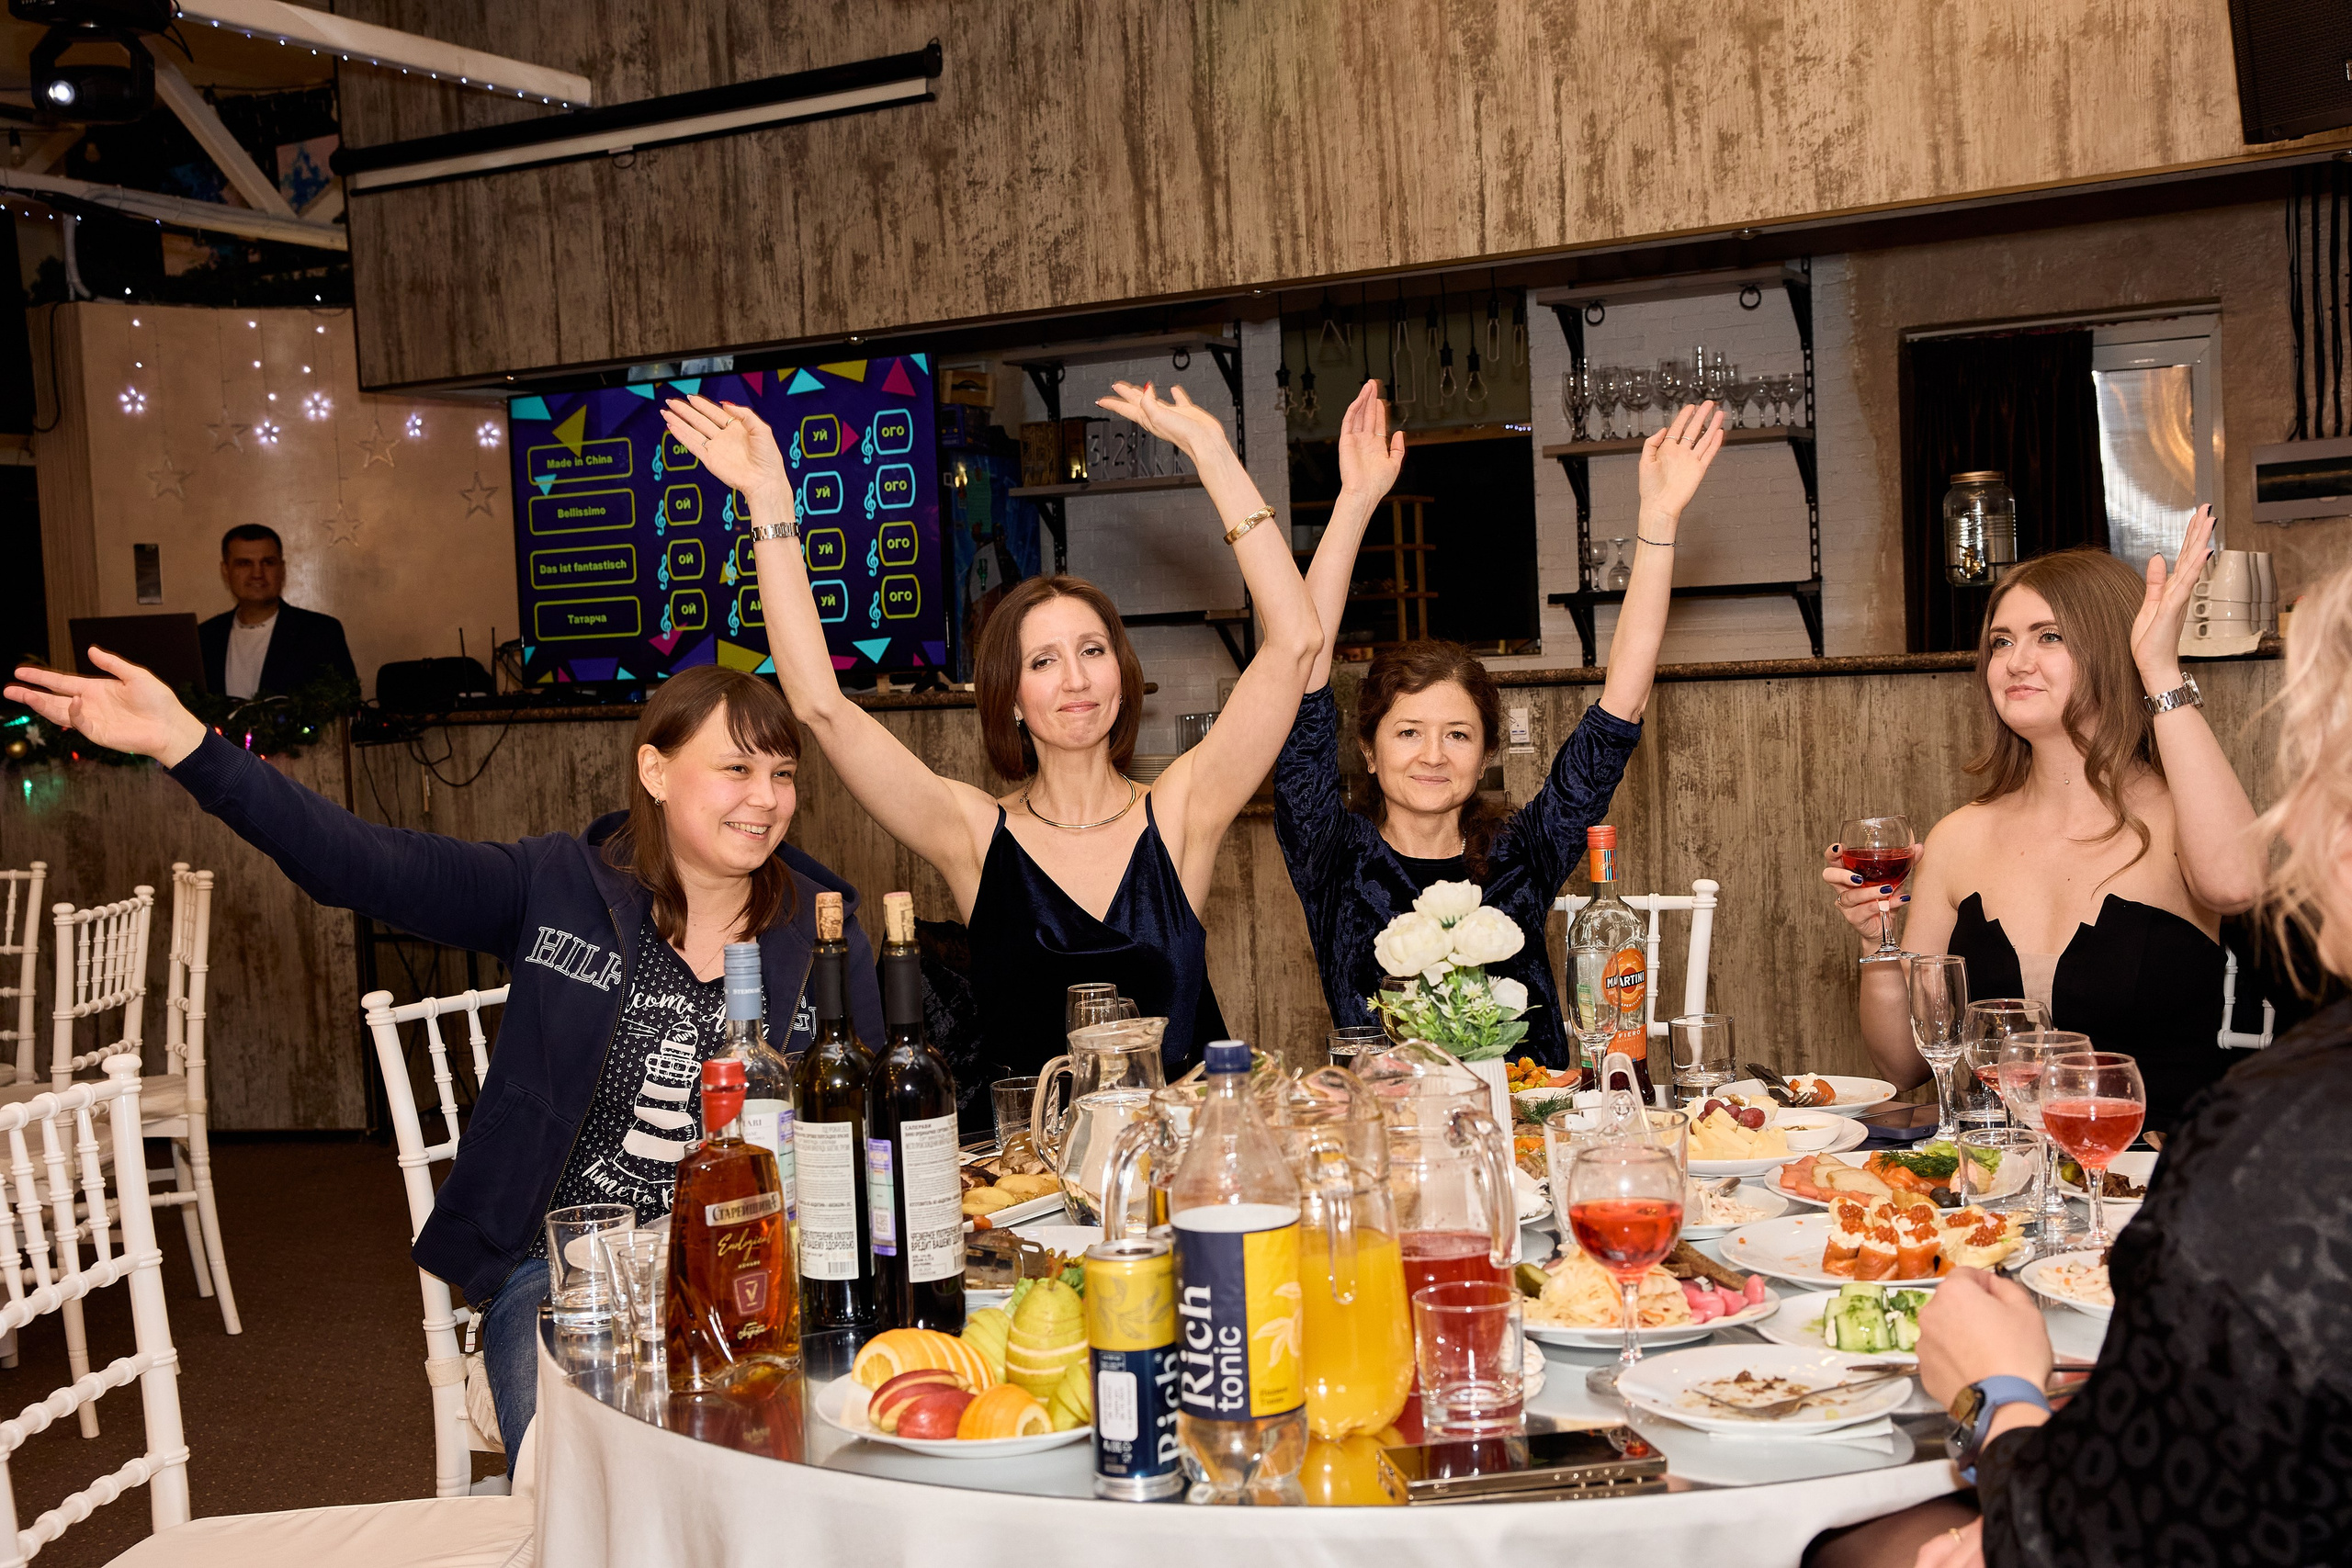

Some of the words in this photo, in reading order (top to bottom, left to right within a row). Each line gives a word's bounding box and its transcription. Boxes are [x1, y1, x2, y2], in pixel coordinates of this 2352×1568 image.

[812, 428, 828, 442] УЙ
[881, 425, 905, 437] ОГО
[547, 458, 572, 468] Made
[574, 457, 583, 467] in
[585, 455, 613, 466] China
[815, 485, 831, 499] УЙ
[884, 479, 908, 492] ОГО
[675, 497, 692, 510] ОЙ
[557, 506, 606, 519] Bellissimo
[818, 542, 833, 556] УЙ
[887, 537, 910, 549] ОГО
[678, 552, 695, 565] ОЙ
[539, 564, 558, 574] Das
[560, 563, 572, 573] ist
[573, 558, 628, 572] fantastisch
[820, 593, 836, 607] УЙ
[888, 590, 913, 603] ОГО
[681, 603, 697, 615] ОЙ
[567, 614, 607, 626] Татарча
[1607, 971, 1645, 988] MARTINI
[1618, 1030, 1641, 1039] FIERO
[1178, 1285, 1216, 1411] Rich
[1213, 1325, 1244, 1413] tonic
